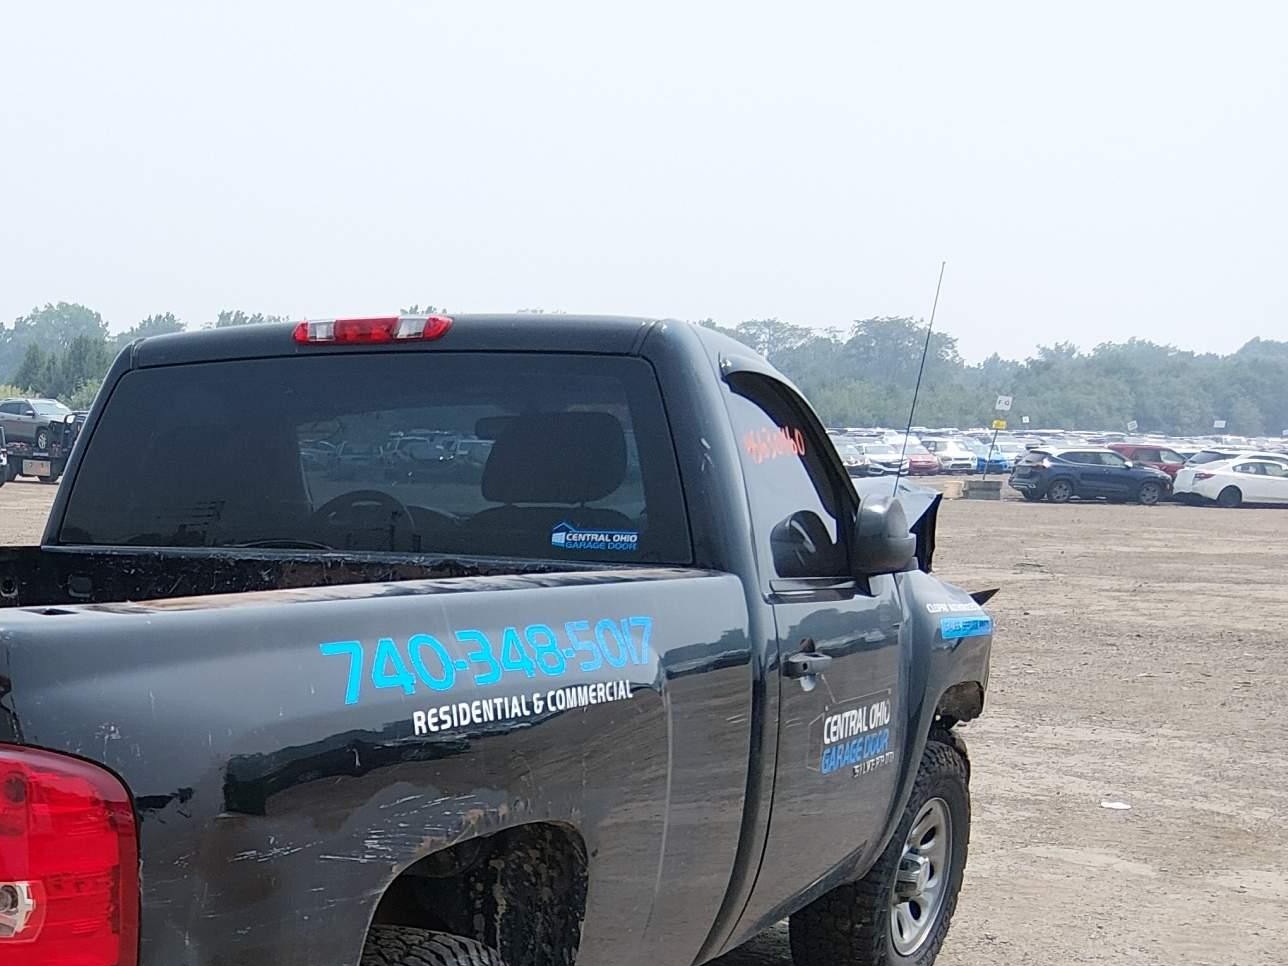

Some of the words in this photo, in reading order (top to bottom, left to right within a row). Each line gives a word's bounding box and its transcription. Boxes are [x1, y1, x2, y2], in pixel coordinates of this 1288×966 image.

[565, 533, 611, 543] CENTRAL
[612, 534, 638, 543] OHIO
[565, 542, 606, 550] GARAGE
[607, 542, 637, 550] DOOR
[319, 615, 654, 706] 740-348-5017
[413, 695, 531, 736] RESIDENTIAL
[532, 692, 545, 715] &
[546, 679, 634, 713] COMMERCIAL
[823, 706, 869, 745] CENTRAL
[868, 699, 891, 730] OHIO
[821, 738, 864, 775] GARAGE
